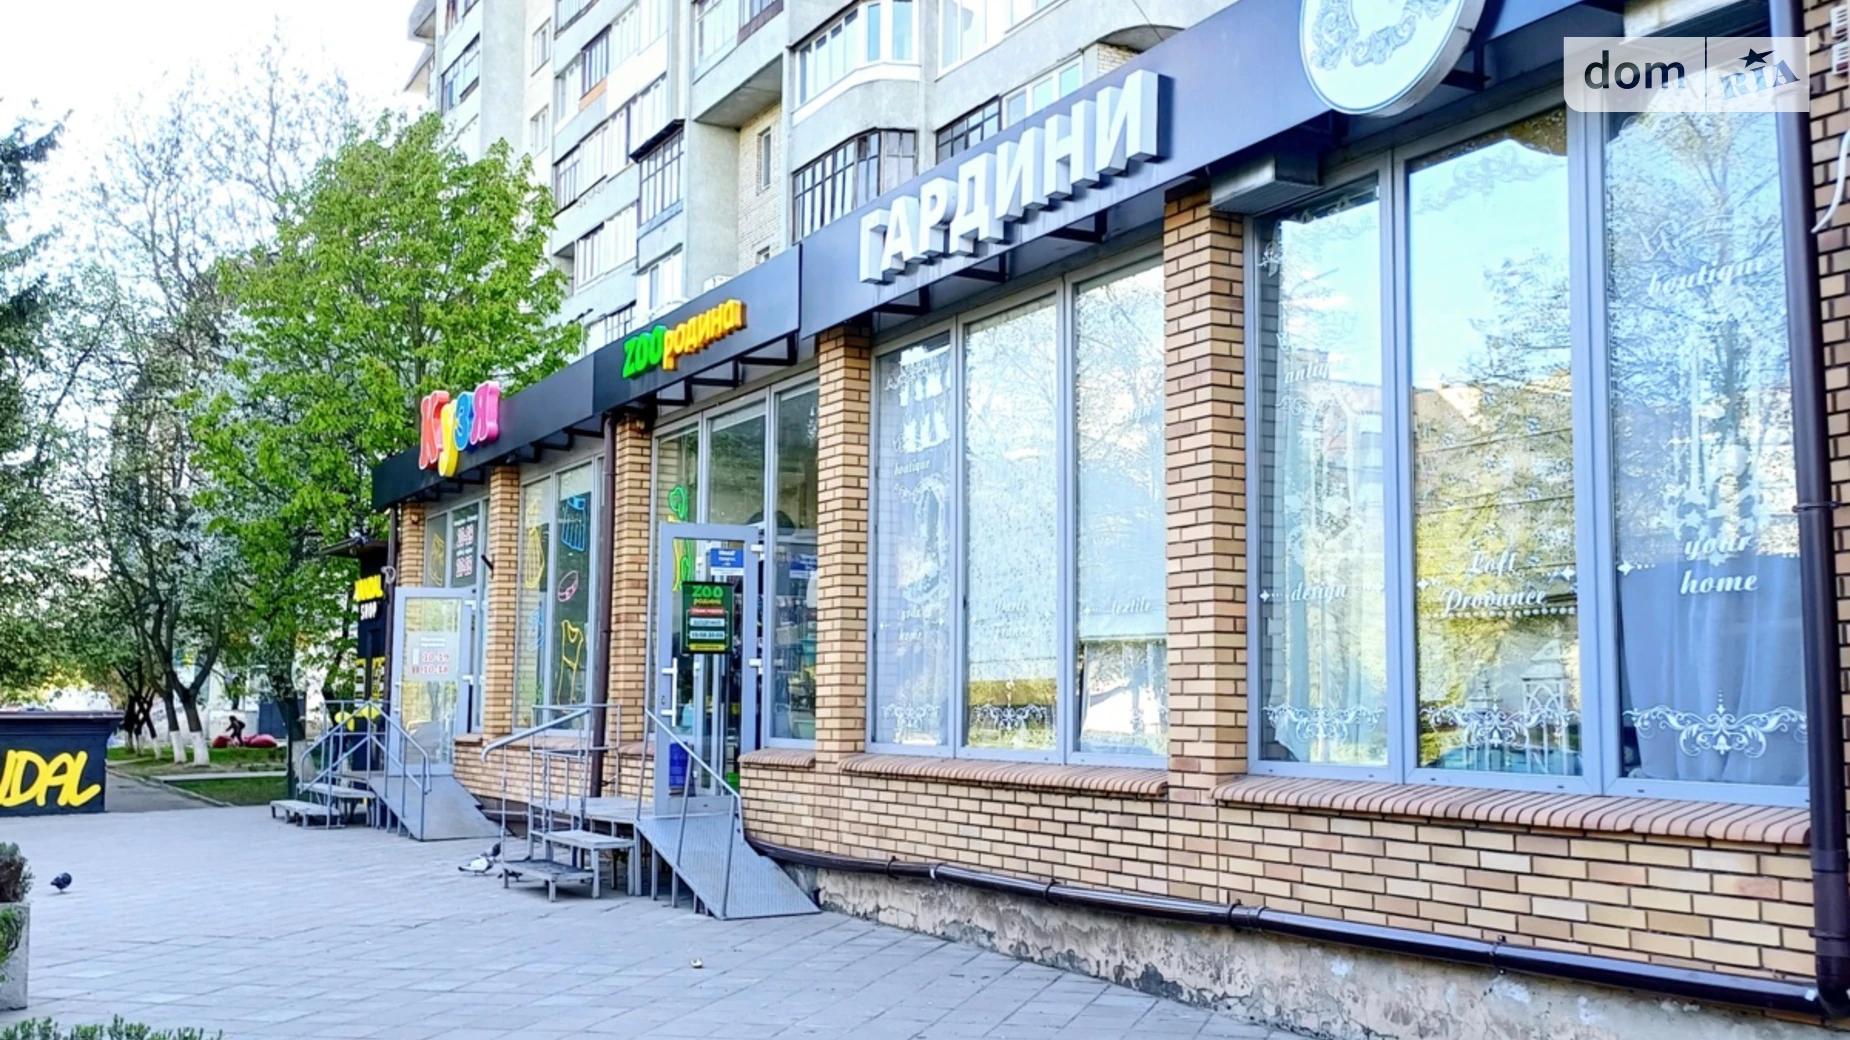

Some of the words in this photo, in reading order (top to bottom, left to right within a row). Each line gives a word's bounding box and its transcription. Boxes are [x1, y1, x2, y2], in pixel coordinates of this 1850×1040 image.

[860, 69, 1160, 284] ГАРДИНИ
[1683, 533, 1754, 561] your
[1466, 550, 1519, 577] Loft
[692, 585, 723, 598] ZOO
[1291, 581, 1347, 604] design
[1680, 569, 1759, 594] home
